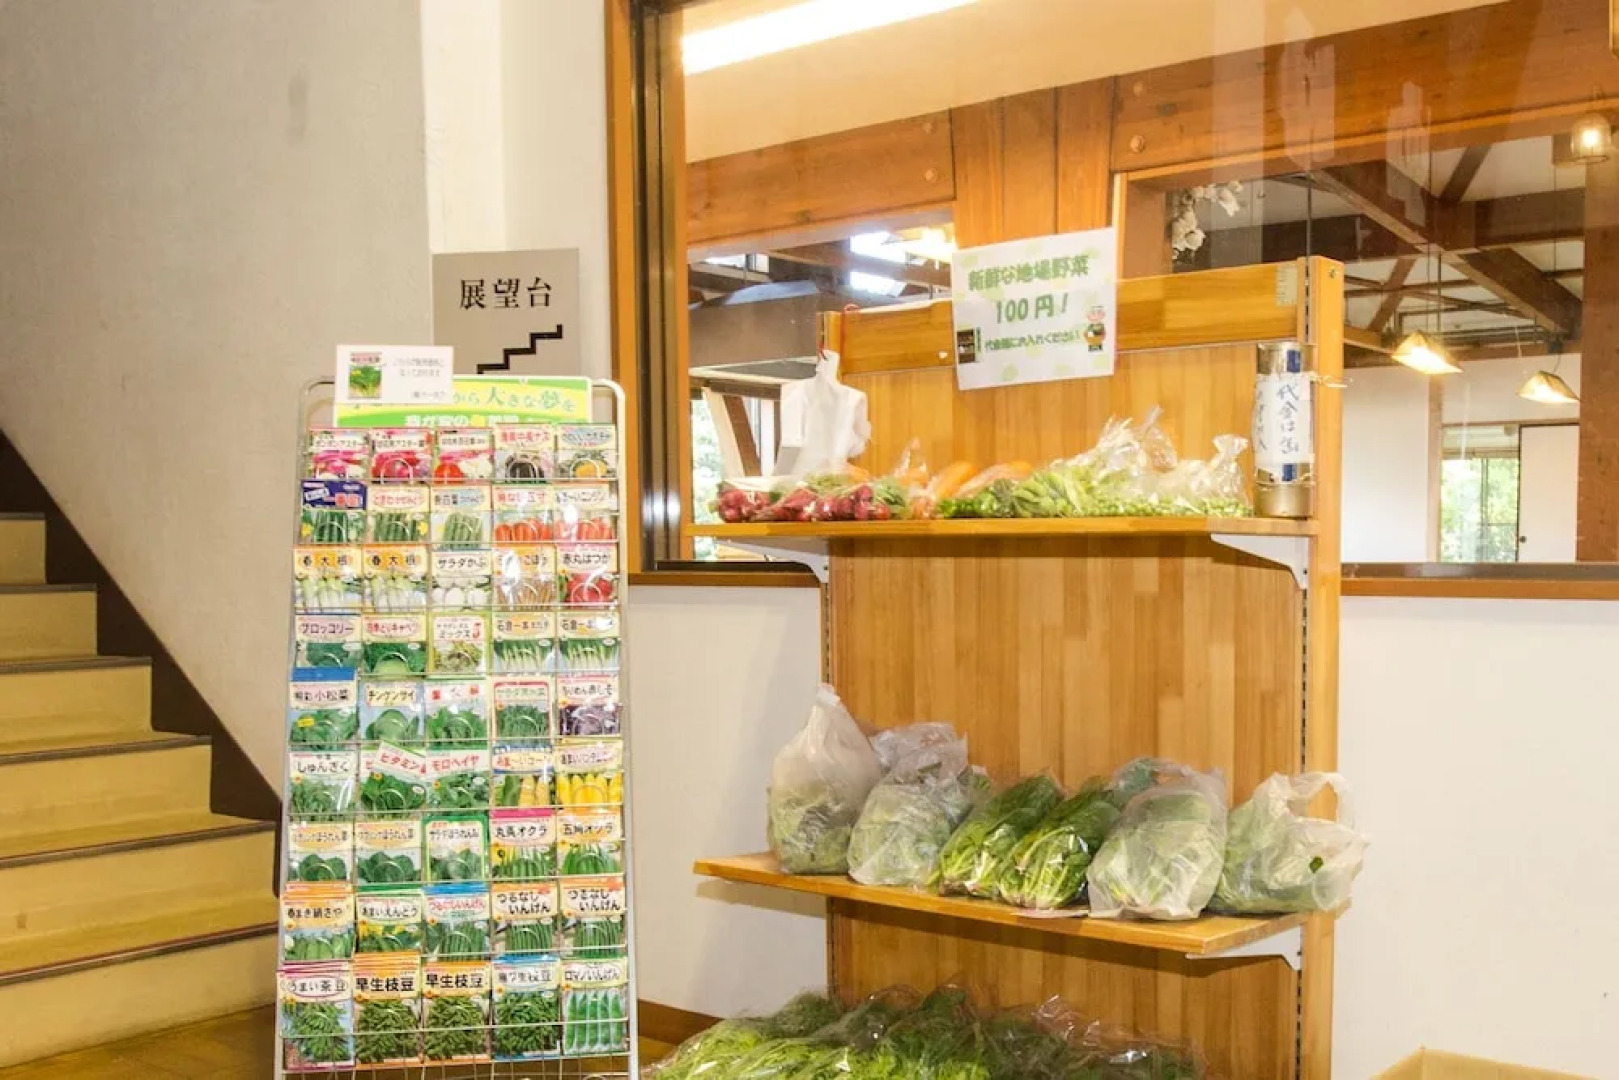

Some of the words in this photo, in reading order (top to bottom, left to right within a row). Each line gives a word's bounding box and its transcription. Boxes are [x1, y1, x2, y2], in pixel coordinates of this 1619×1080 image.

[968, 255, 1089, 291] 新鮮な地場野菜
[459, 276, 552, 310] 展望台
[371, 554, 417, 567] 春大根
[438, 558, 486, 569] サラダかぶ
[301, 622, 354, 635] ブロッコリー
[367, 689, 414, 701] チンゲンサイ
[431, 756, 480, 771] モロヘイヤ
[499, 892, 540, 903] つるなし
[509, 903, 551, 915] いんげん
[579, 901, 621, 912] いんげん
[355, 977, 415, 993] 早生枝豆
[425, 974, 483, 989] 早生枝豆
